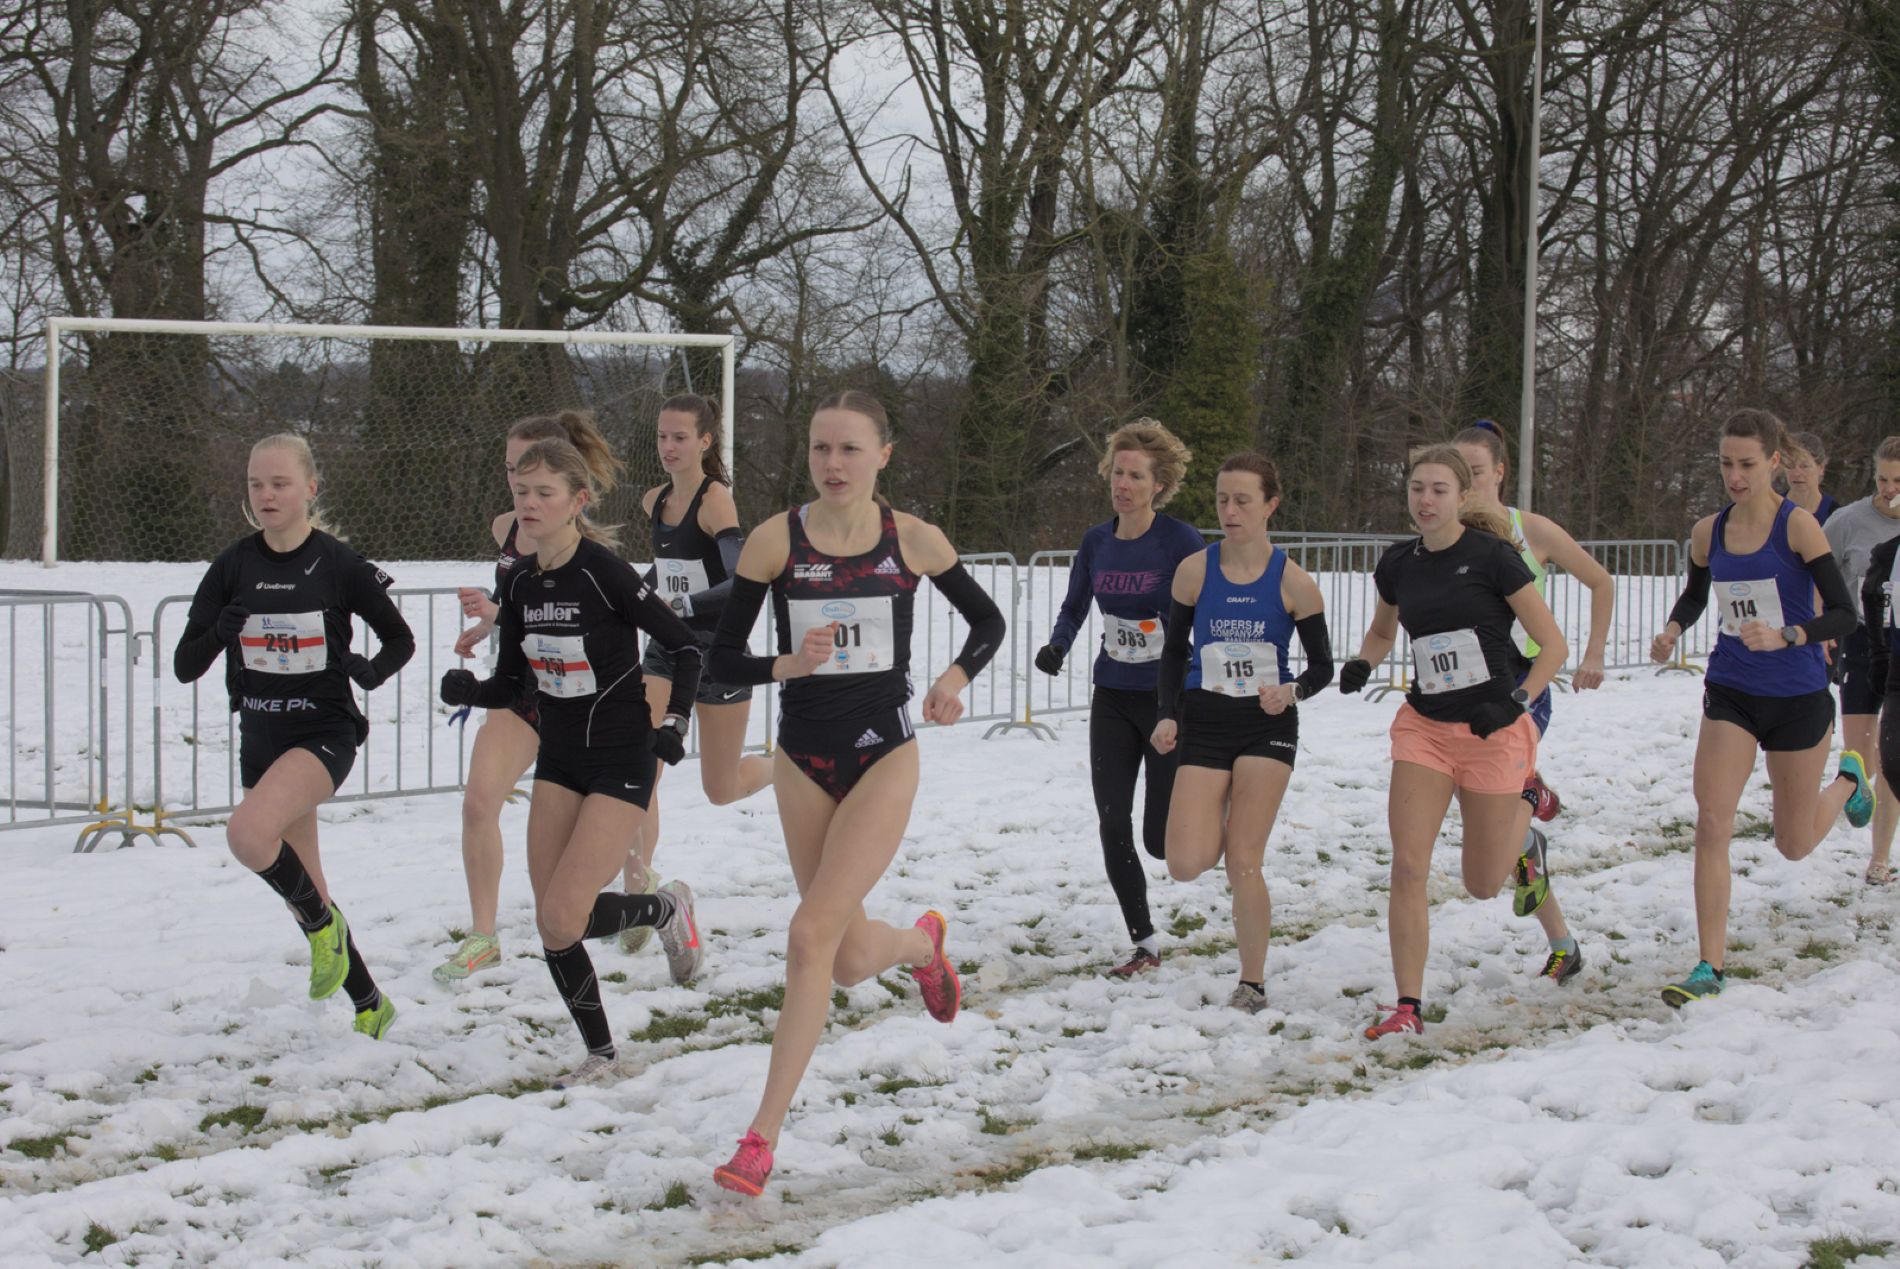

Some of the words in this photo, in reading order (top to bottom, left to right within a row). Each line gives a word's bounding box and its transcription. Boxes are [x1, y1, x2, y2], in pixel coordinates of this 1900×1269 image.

[665, 575, 689, 593] 106
[1099, 573, 1146, 592] RUN
[524, 602, 580, 622] keller
[1730, 599, 1757, 618] 114
[1209, 619, 1252, 630] LOPERS
[1211, 629, 1253, 638] COMPANY
[264, 633, 300, 654] 251
[825, 623, 861, 648] 01
[1117, 629, 1147, 648] 383
[1223, 660, 1254, 678] 115
[1430, 651, 1459, 674] 107
[243, 695, 282, 712] NIKE
